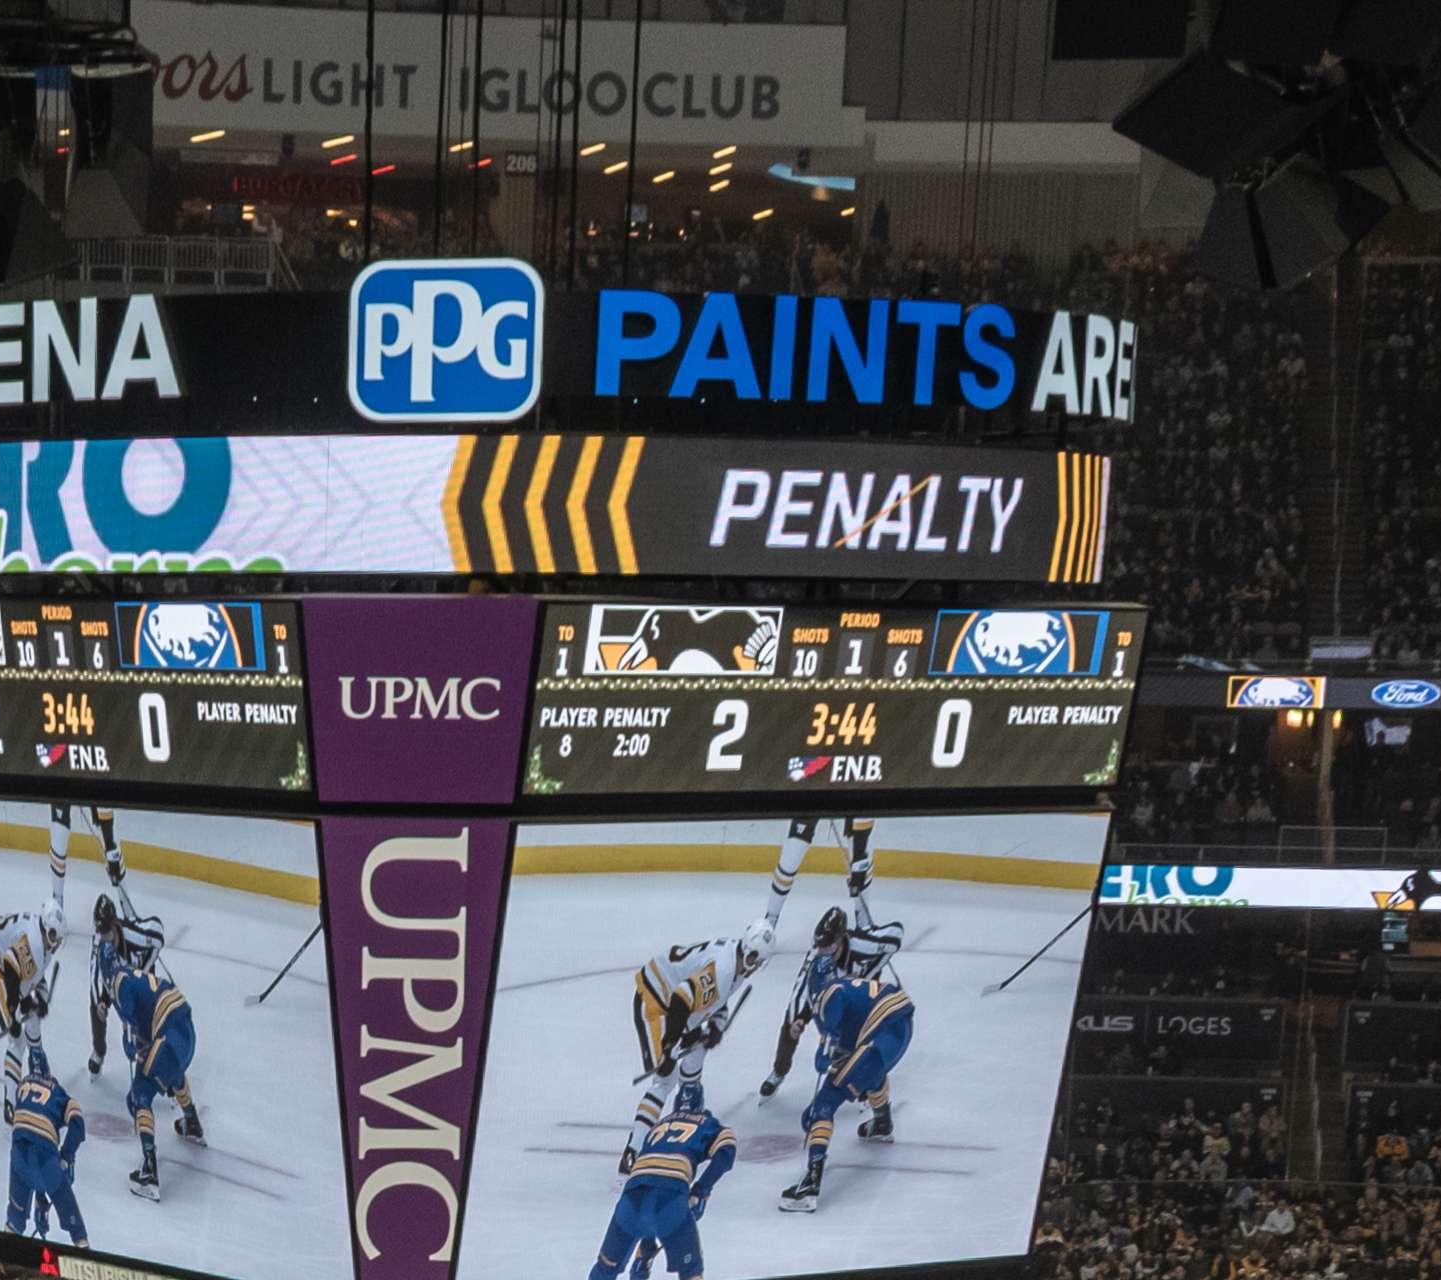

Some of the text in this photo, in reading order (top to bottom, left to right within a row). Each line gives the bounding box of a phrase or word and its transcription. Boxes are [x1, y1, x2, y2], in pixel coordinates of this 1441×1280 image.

[262, 58, 417, 110] LIGHT
[458, 64, 780, 119] IGLOO CLUB
[363, 279, 1017, 411] PPG PAINTS
[709, 468, 1023, 554] PENALTY
[840, 612, 880, 628] PERIOD
[793, 628, 830, 644] SHOTS
[888, 629, 923, 644] SHOTS
[17, 641, 35, 667] 10
[792, 649, 818, 677] 10
[845, 639, 863, 675] 1
[893, 650, 907, 677] 6
[338, 676, 502, 721] UPMC
[1383, 684, 1428, 704] Ford
[42, 692, 95, 736] 3:44
[197, 701, 298, 725] PLAYER PENALTY
[540, 707, 670, 728] PLAYER PENALTY
[806, 702, 877, 746] 3:44
[1007, 705, 1123, 725] PLAYER PENALTY
[138, 692, 171, 763] 0
[706, 698, 749, 771] 2
[931, 698, 972, 768] 0
[68, 744, 110, 771] F.N.B.
[612, 734, 650, 757] 2:00
[830, 755, 882, 782] F.N.B.
[350, 826, 472, 1266] UPMC
